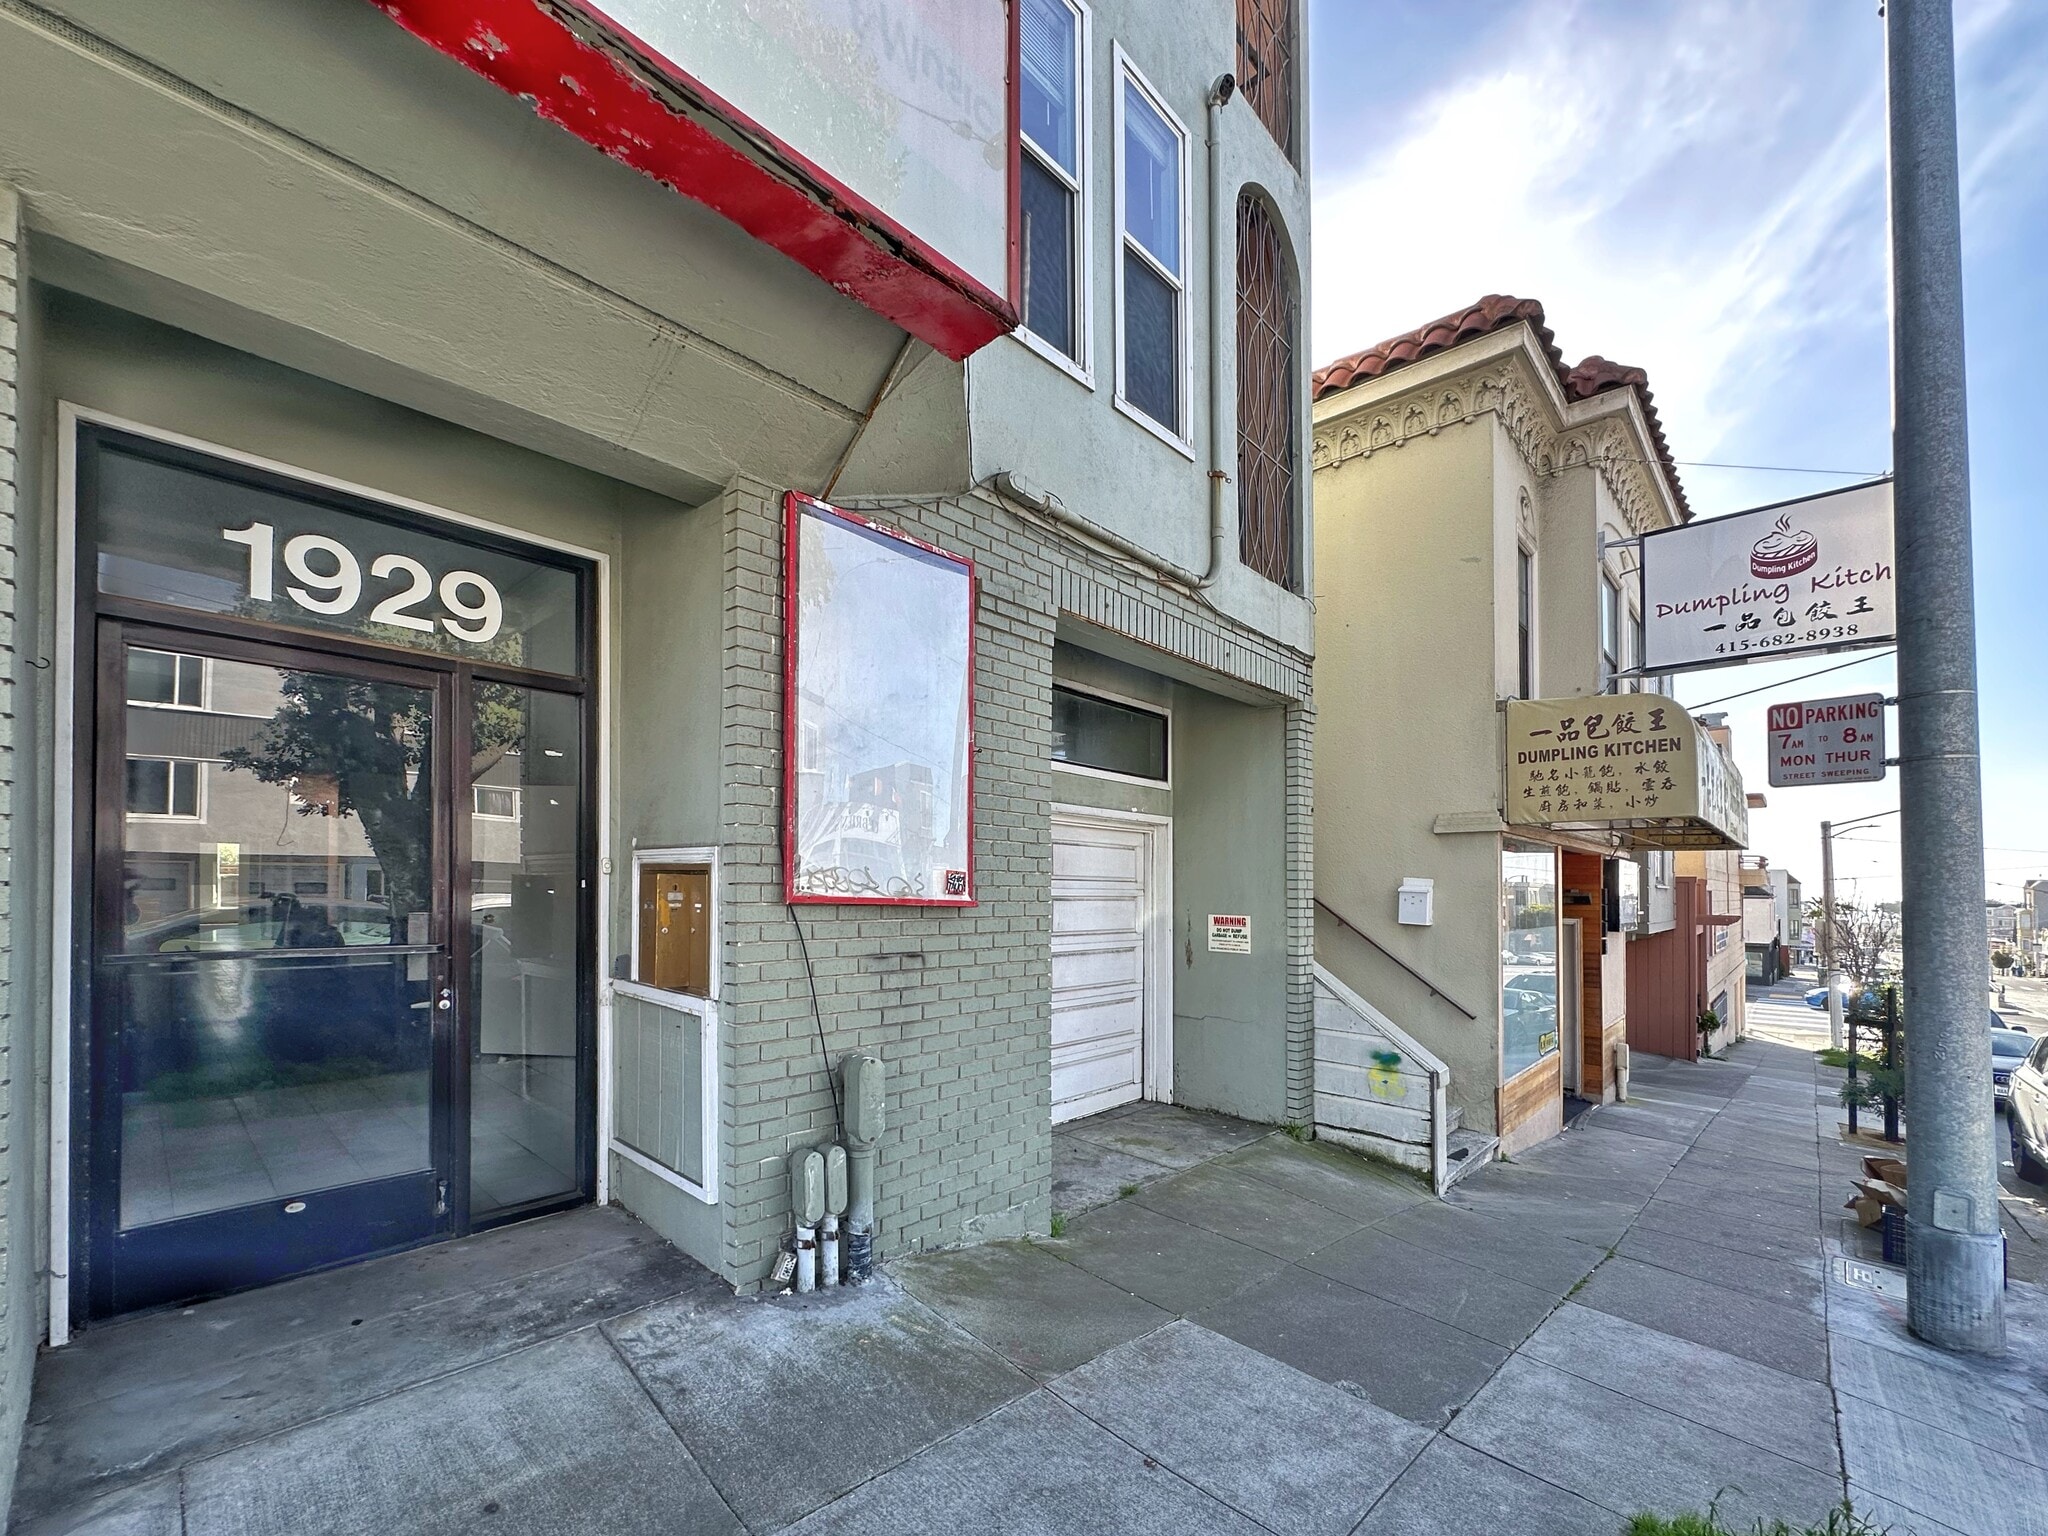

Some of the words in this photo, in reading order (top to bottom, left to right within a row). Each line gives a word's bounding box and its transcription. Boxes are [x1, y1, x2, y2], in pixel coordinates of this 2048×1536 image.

[1752, 562, 1786, 575] Dumpling
[1787, 551, 1816, 570] Kitchen
[223, 522, 503, 643] 1929
[1656, 583, 1790, 618] Dumpling
[1703, 596, 1874, 632] 一品包餃王
[1715, 624, 1859, 654] 415-682-8938
[1529, 707, 1668, 743] 一品包餃王
[1772, 707, 1799, 729] NO
[1805, 701, 1878, 724] PARKING
[1518, 744, 1599, 765] DUMPLING
[1604, 737, 1682, 757] KITCHEN
[1780, 754, 1815, 767] MON
[1825, 750, 1871, 763] THUR
[1783, 772, 1816, 780] STREET
[1821, 768, 1869, 778] SWEEPING
[1213, 916, 1246, 926] WARNING
